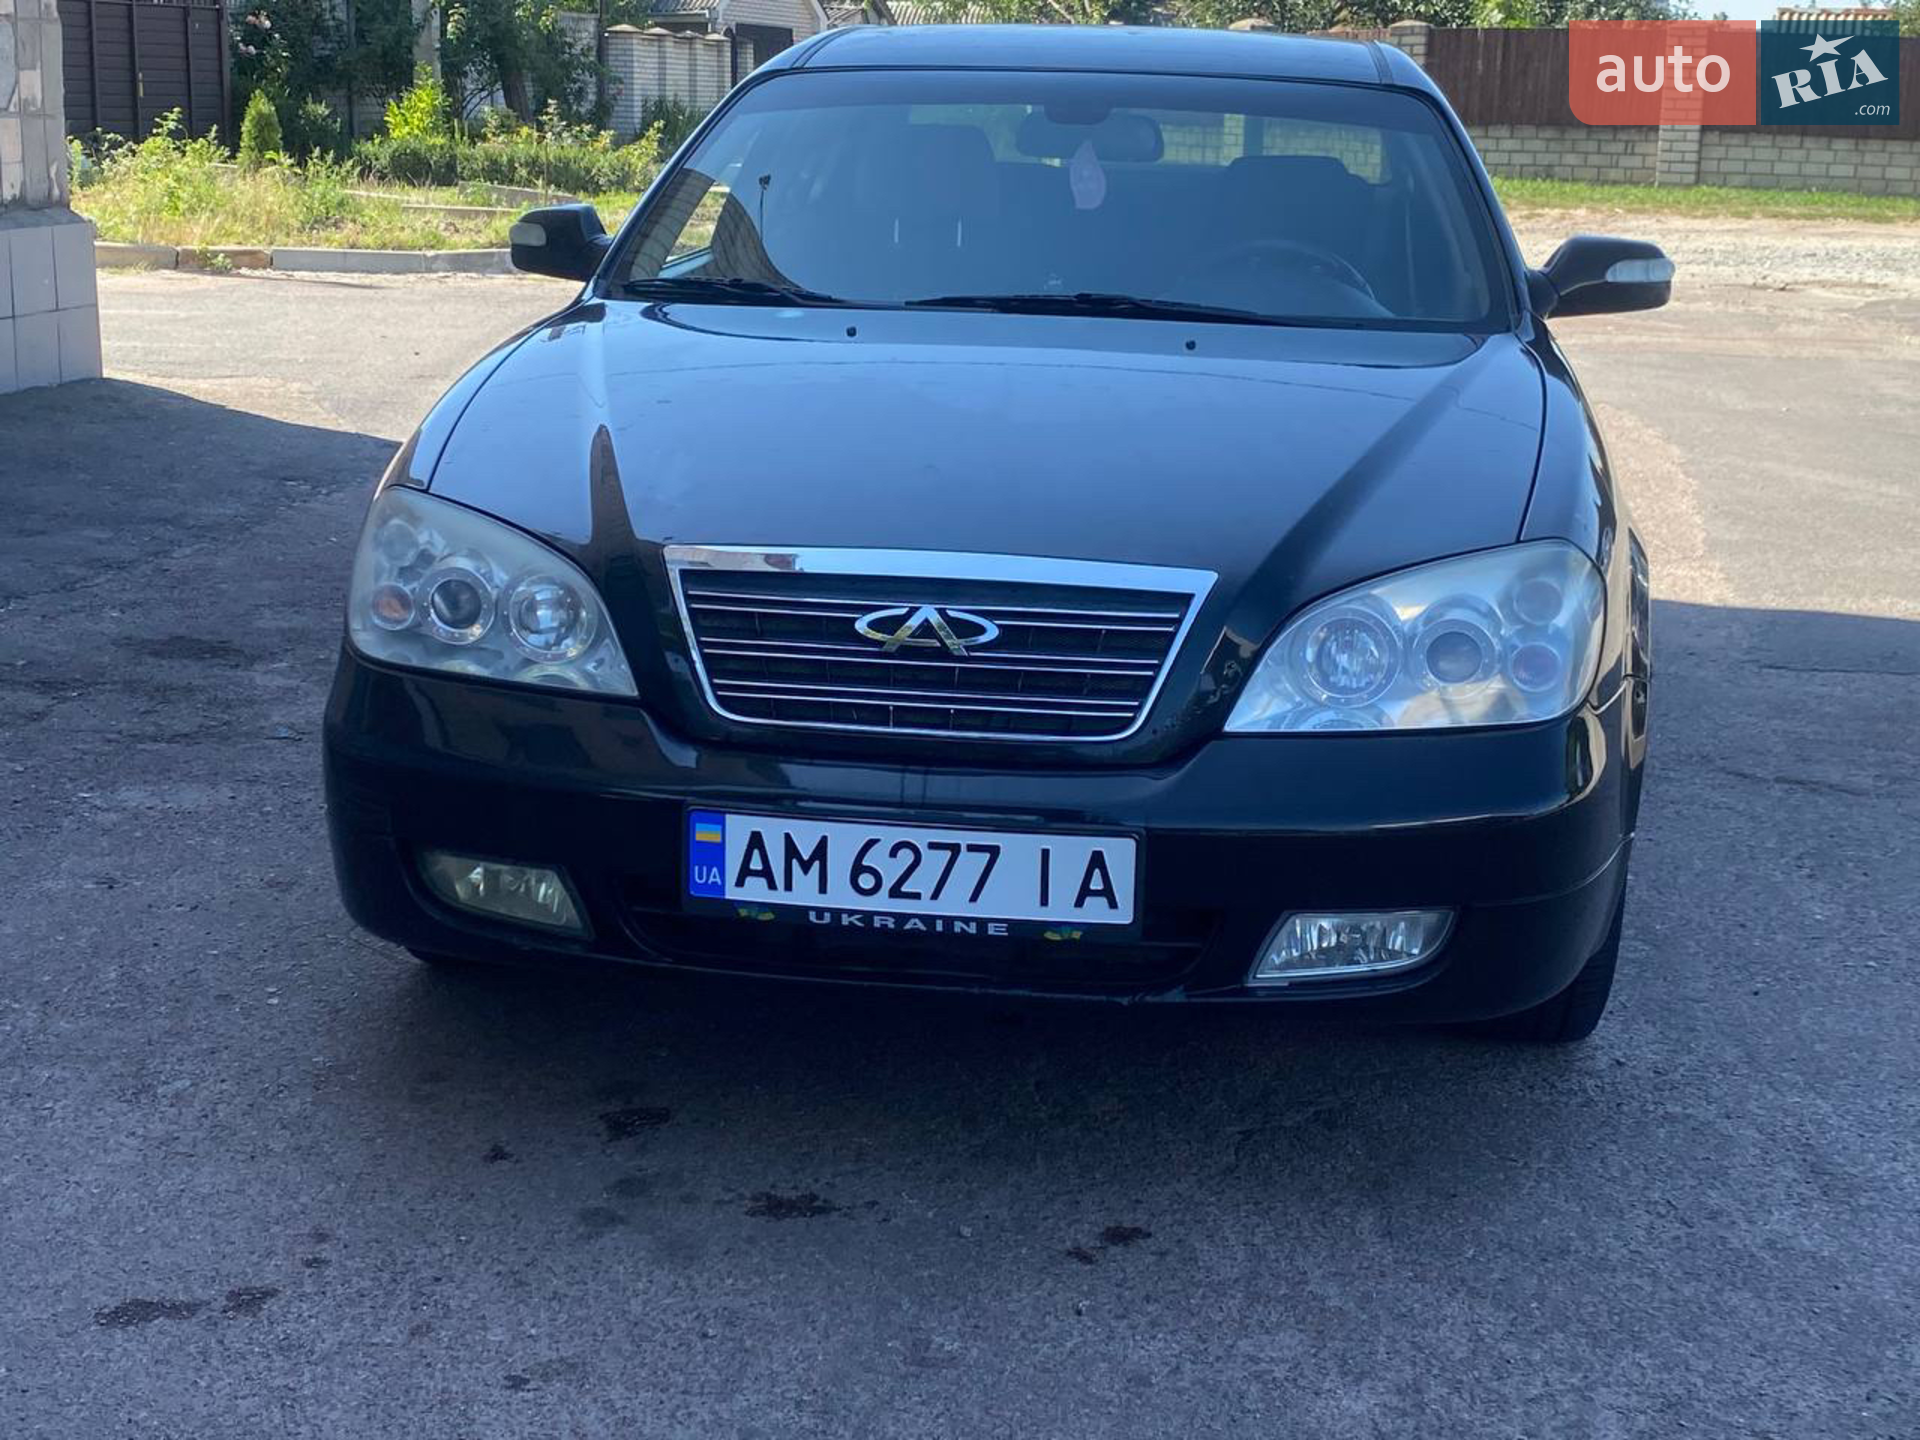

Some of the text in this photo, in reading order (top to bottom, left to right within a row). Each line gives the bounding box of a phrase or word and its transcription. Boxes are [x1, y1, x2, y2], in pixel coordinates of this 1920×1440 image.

[694, 865, 722, 886] UA
[734, 830, 1119, 910] AM 6277 IA
[808, 910, 1009, 936] UKRAINE
